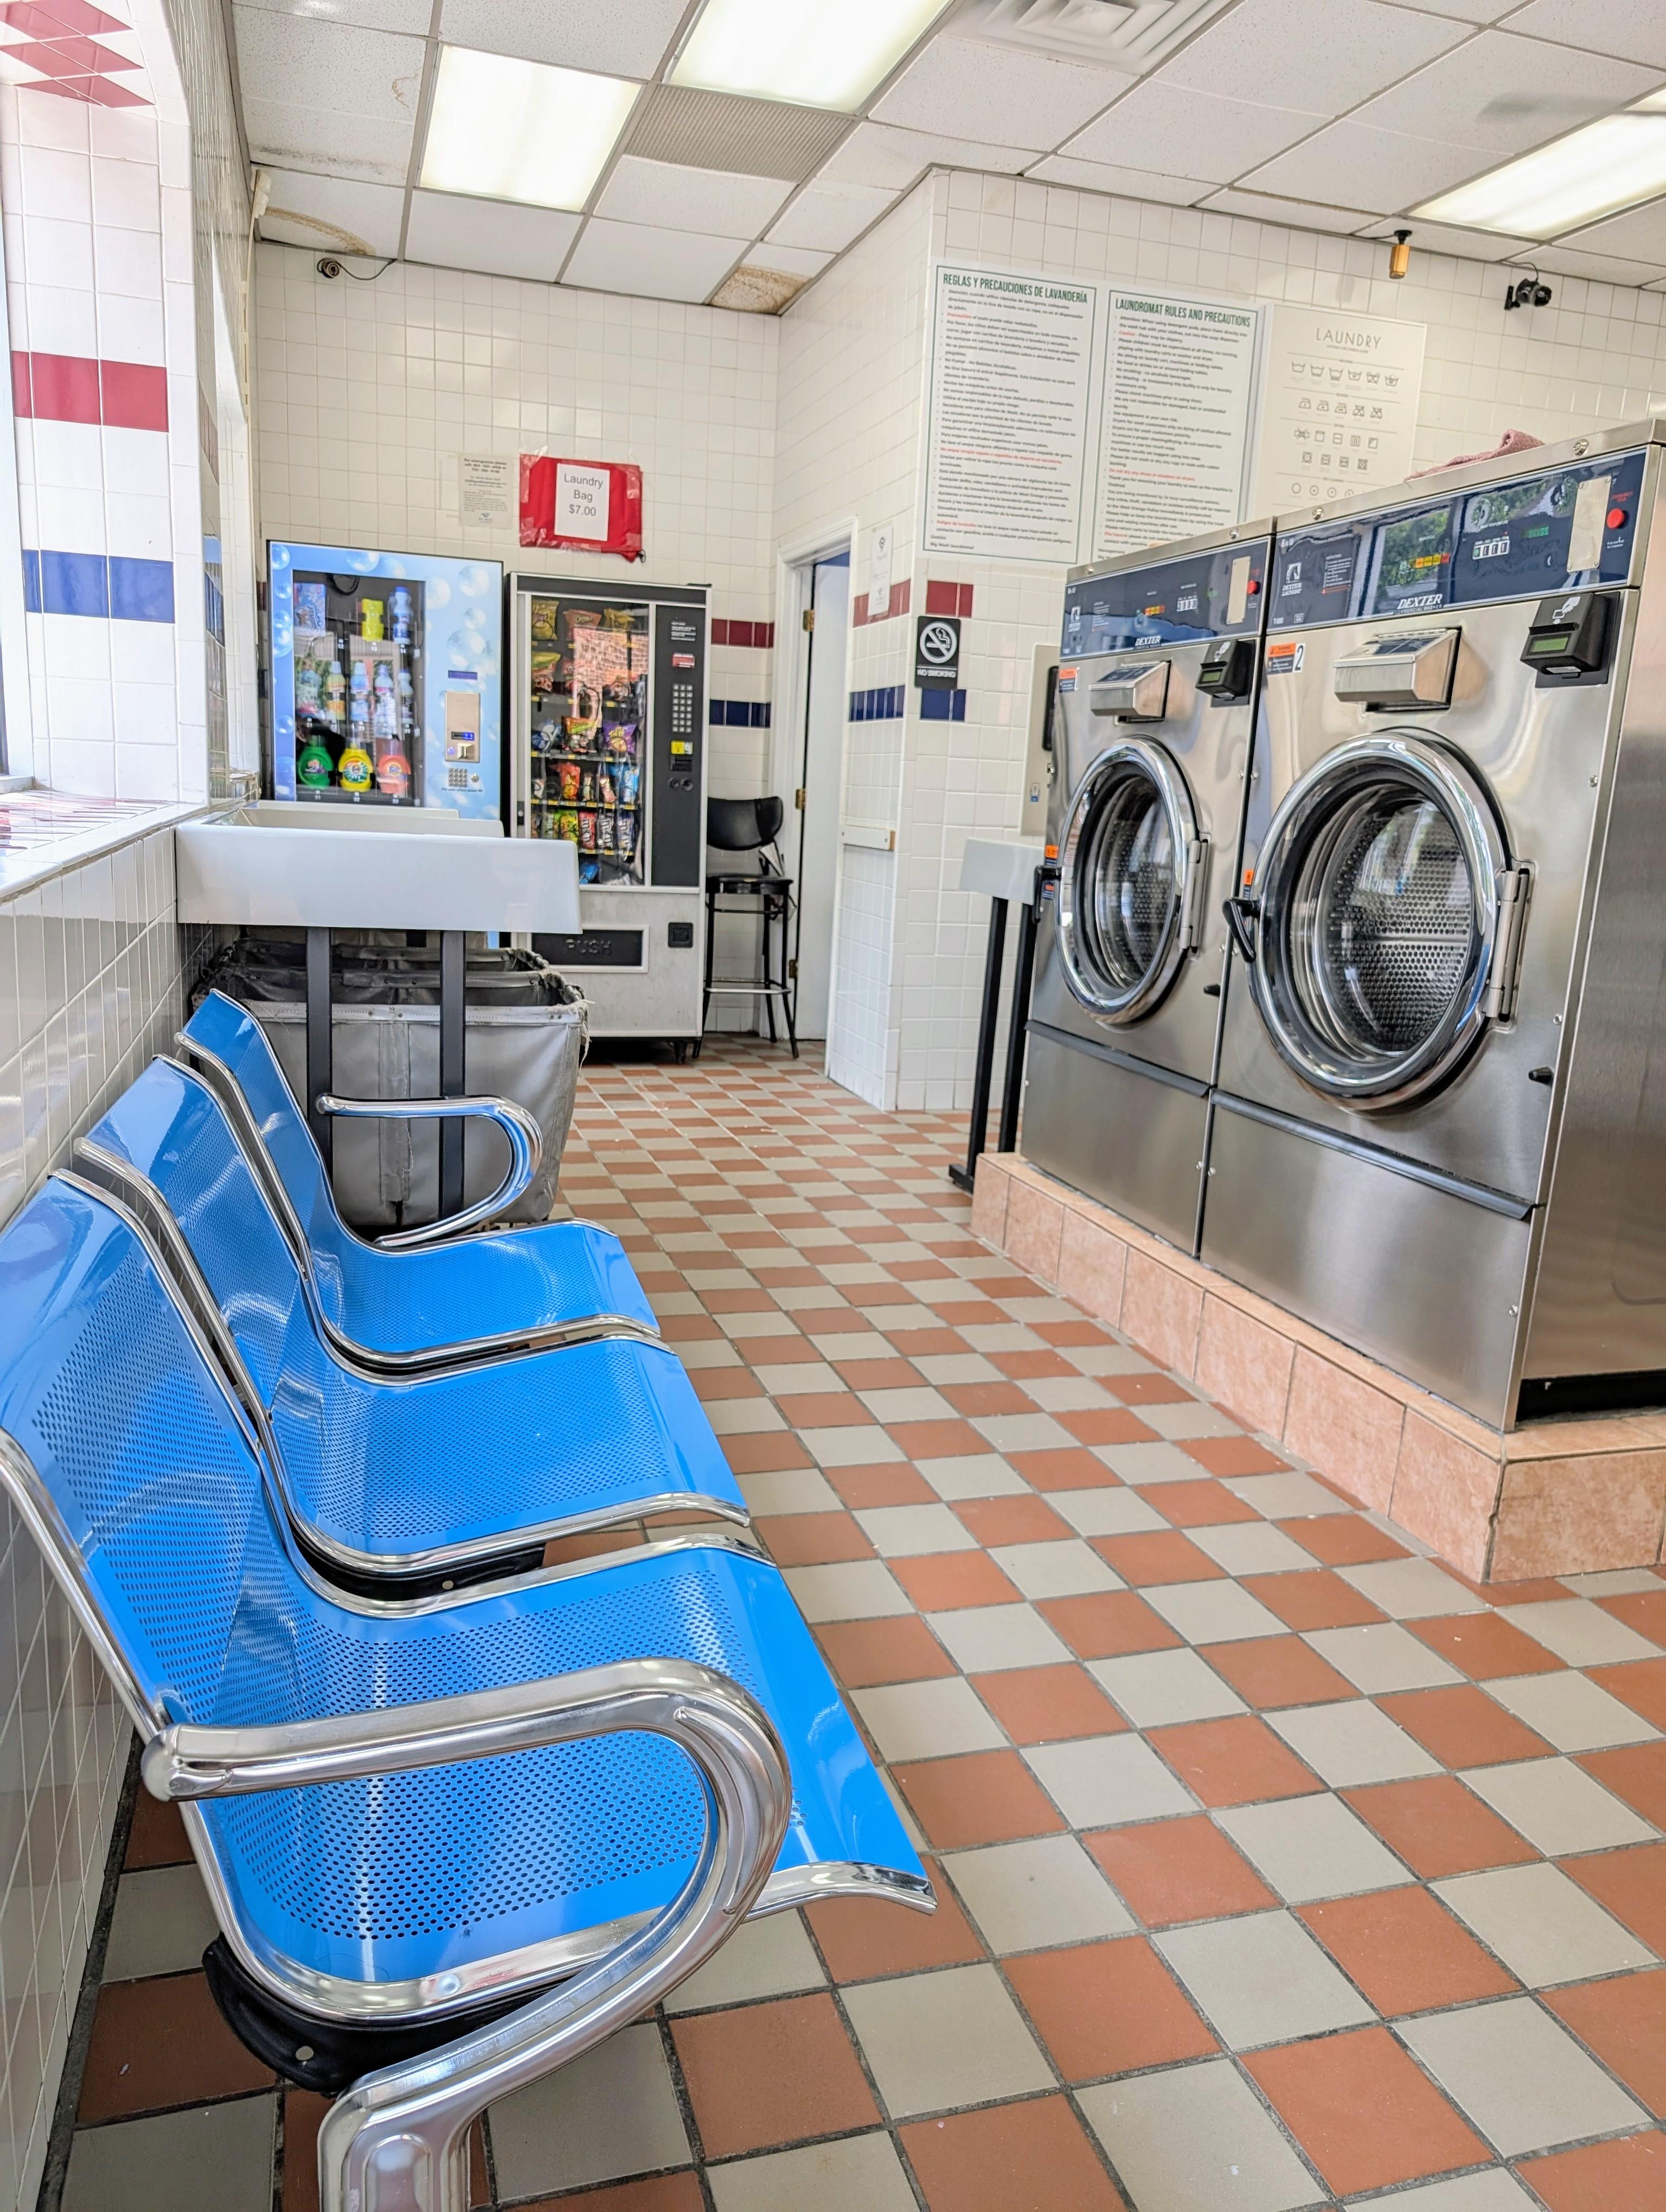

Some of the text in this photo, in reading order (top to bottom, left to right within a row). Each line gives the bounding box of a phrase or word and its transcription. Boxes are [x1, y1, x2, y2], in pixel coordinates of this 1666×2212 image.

[943, 273, 1087, 304] REGLAS Y PRECAUCIONES DE LAVANDERÍA
[1115, 298, 1250, 327] LAUNDROMAT RULES AND PRECAUTIONS
[1316, 328, 1381, 349] LAUNDRY
[564, 473, 603, 490] Laundry
[574, 490, 593, 503] Bag
[568, 504, 597, 516] $7.00
[1396, 593, 1443, 610] DEXTER
[1135, 635, 1161, 646] DEXTER
[1295, 645, 1304, 671] 2
[927, 670, 956, 678] SMOKING
